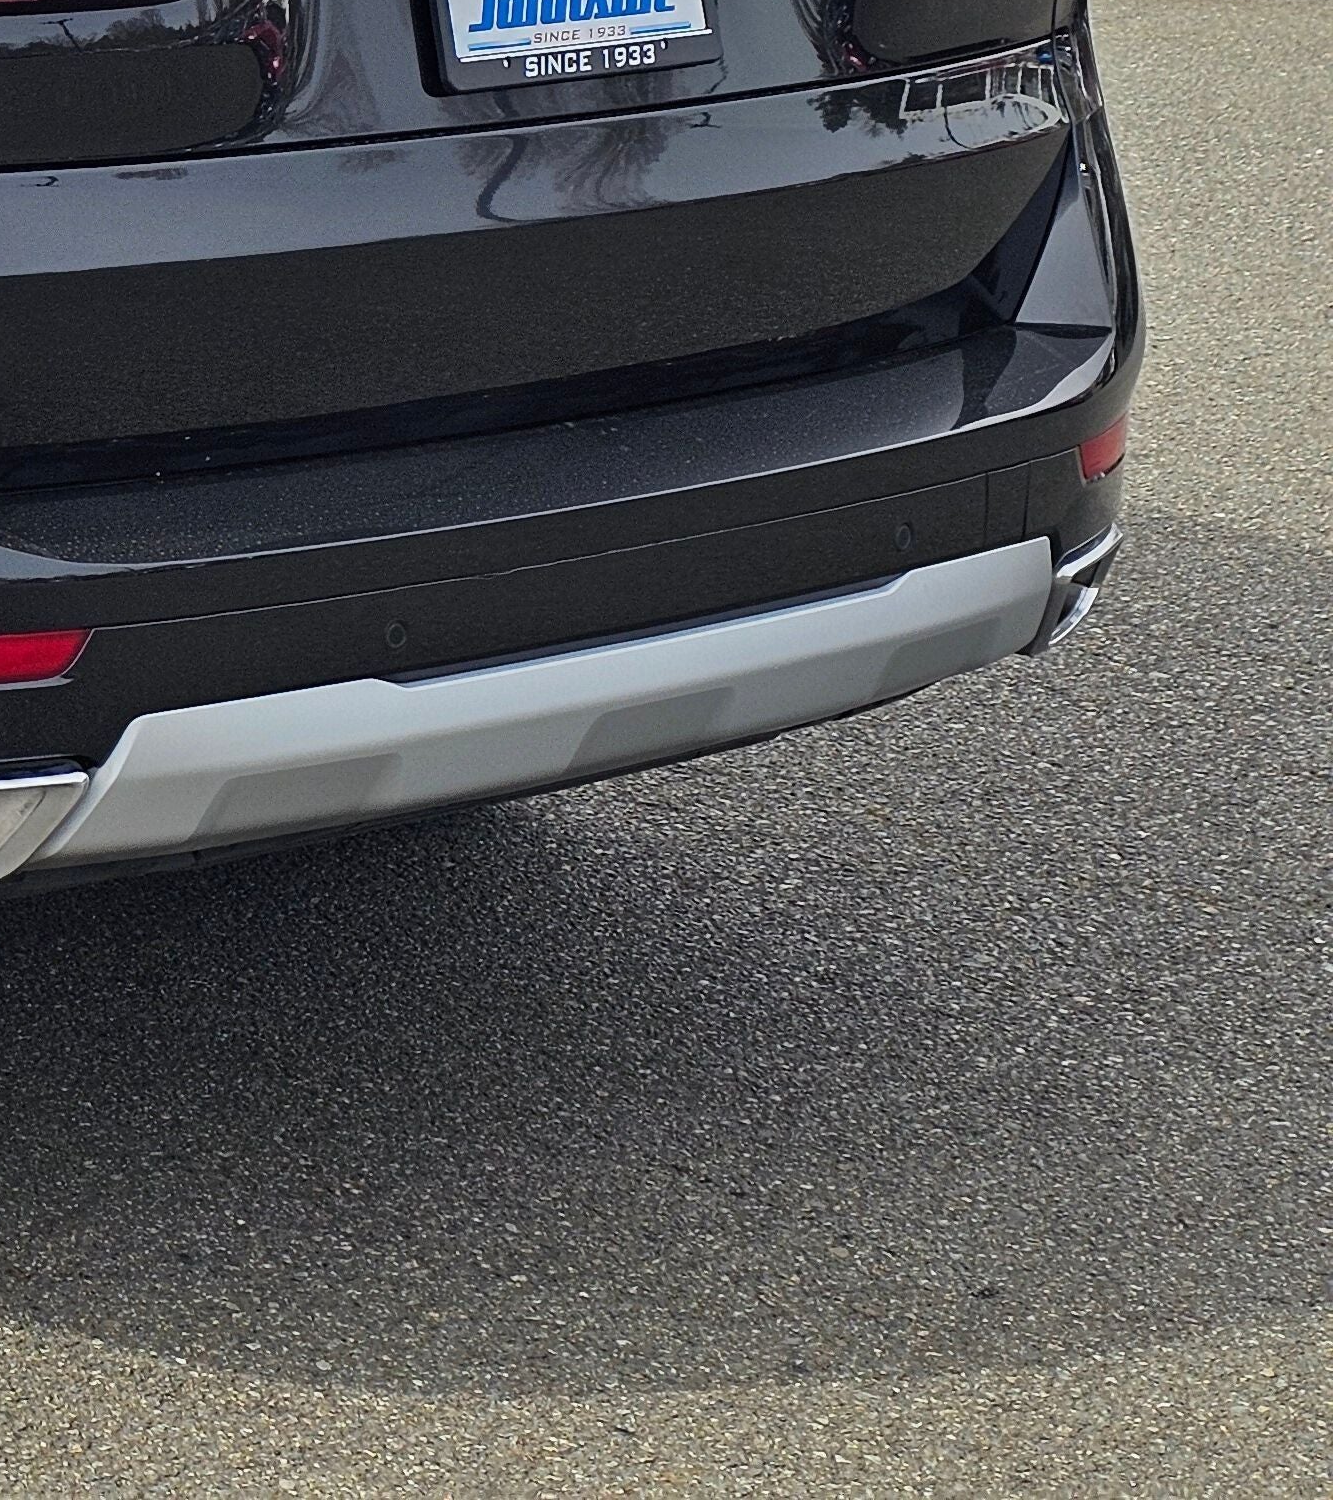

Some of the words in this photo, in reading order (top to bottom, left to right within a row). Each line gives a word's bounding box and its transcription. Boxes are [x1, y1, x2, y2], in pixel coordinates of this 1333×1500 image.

[533, 29, 581, 44] SINCE
[589, 25, 626, 38] 1933
[525, 51, 592, 78] SINCE
[602, 44, 657, 69] 1933
